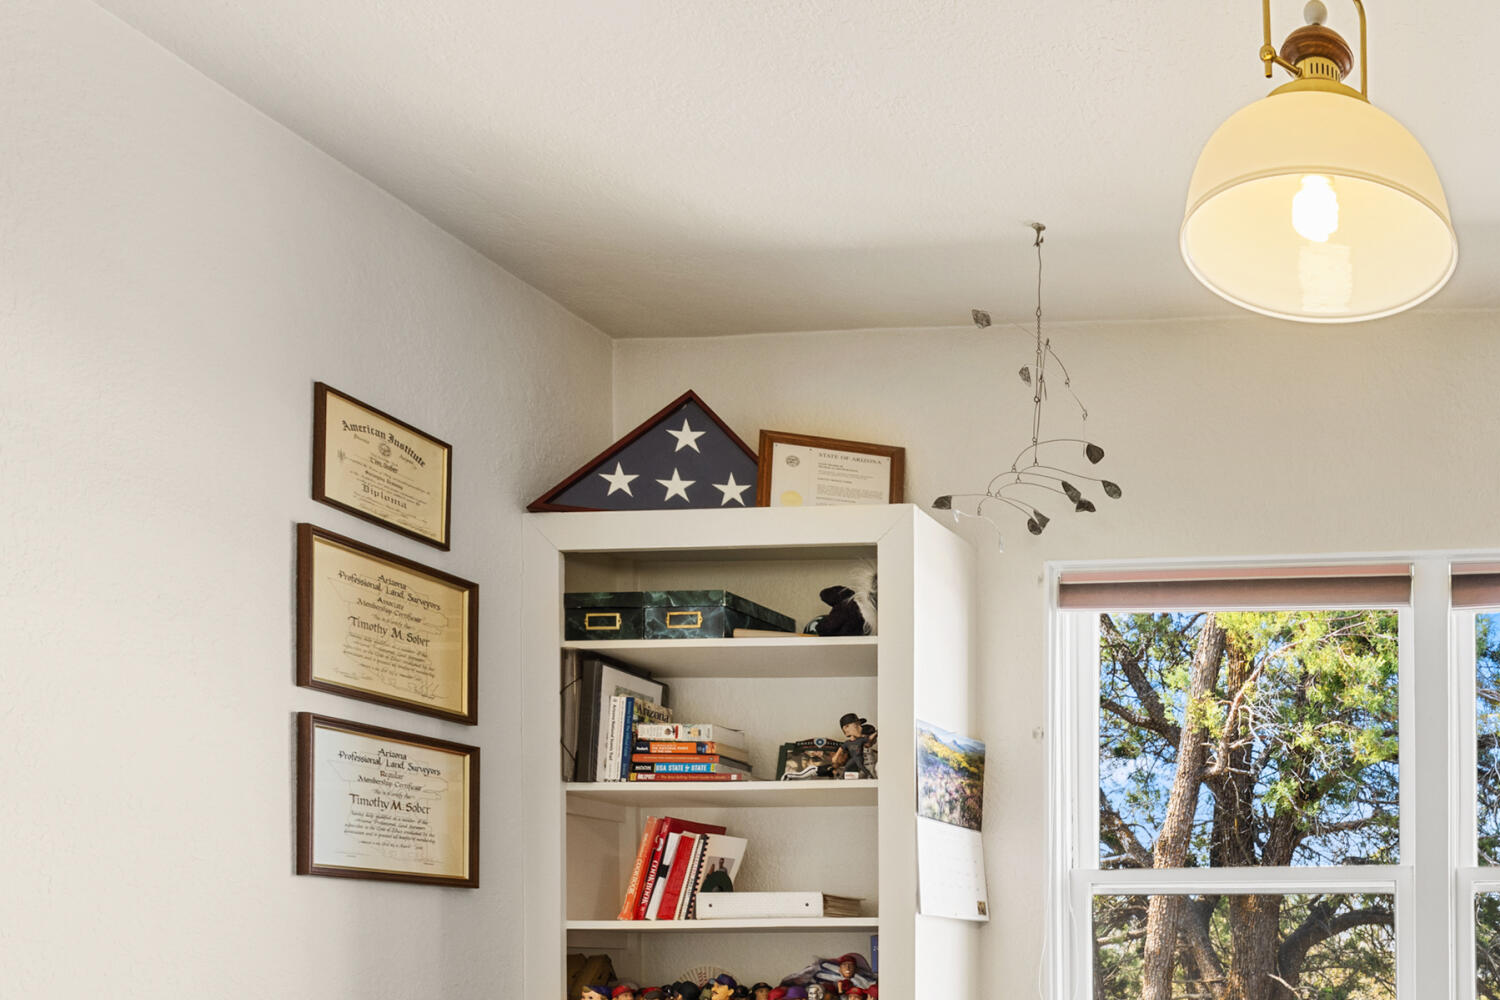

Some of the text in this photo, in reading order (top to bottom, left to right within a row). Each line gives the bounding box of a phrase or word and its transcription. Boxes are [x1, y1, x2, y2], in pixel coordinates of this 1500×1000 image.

[341, 420, 386, 440] American
[387, 432, 426, 468] Institute
[818, 452, 838, 460] STATE
[852, 457, 882, 465] ARIZONA
[361, 483, 408, 510] Diploma
[338, 569, 441, 612] Professional Land Surveyors
[377, 574, 407, 590] Arizona
[347, 614, 389, 638] Timothy
[390, 627, 405, 641] M.
[406, 633, 431, 648] Sober
[636, 702, 669, 723] Arizona
[338, 750, 441, 778] Professional Land Surveyors
[377, 748, 407, 761] Arizona
[380, 770, 404, 782] Regular
[656, 763, 667, 772] USA
[668, 763, 684, 772] STATE
[691, 763, 707, 772] STATE
[357, 775, 393, 789] Membership
[348, 793, 390, 813] Timothy
[390, 799, 404, 811] M.
[406, 803, 432, 815] Sober
[641, 860, 658, 904] COOKBOOK
